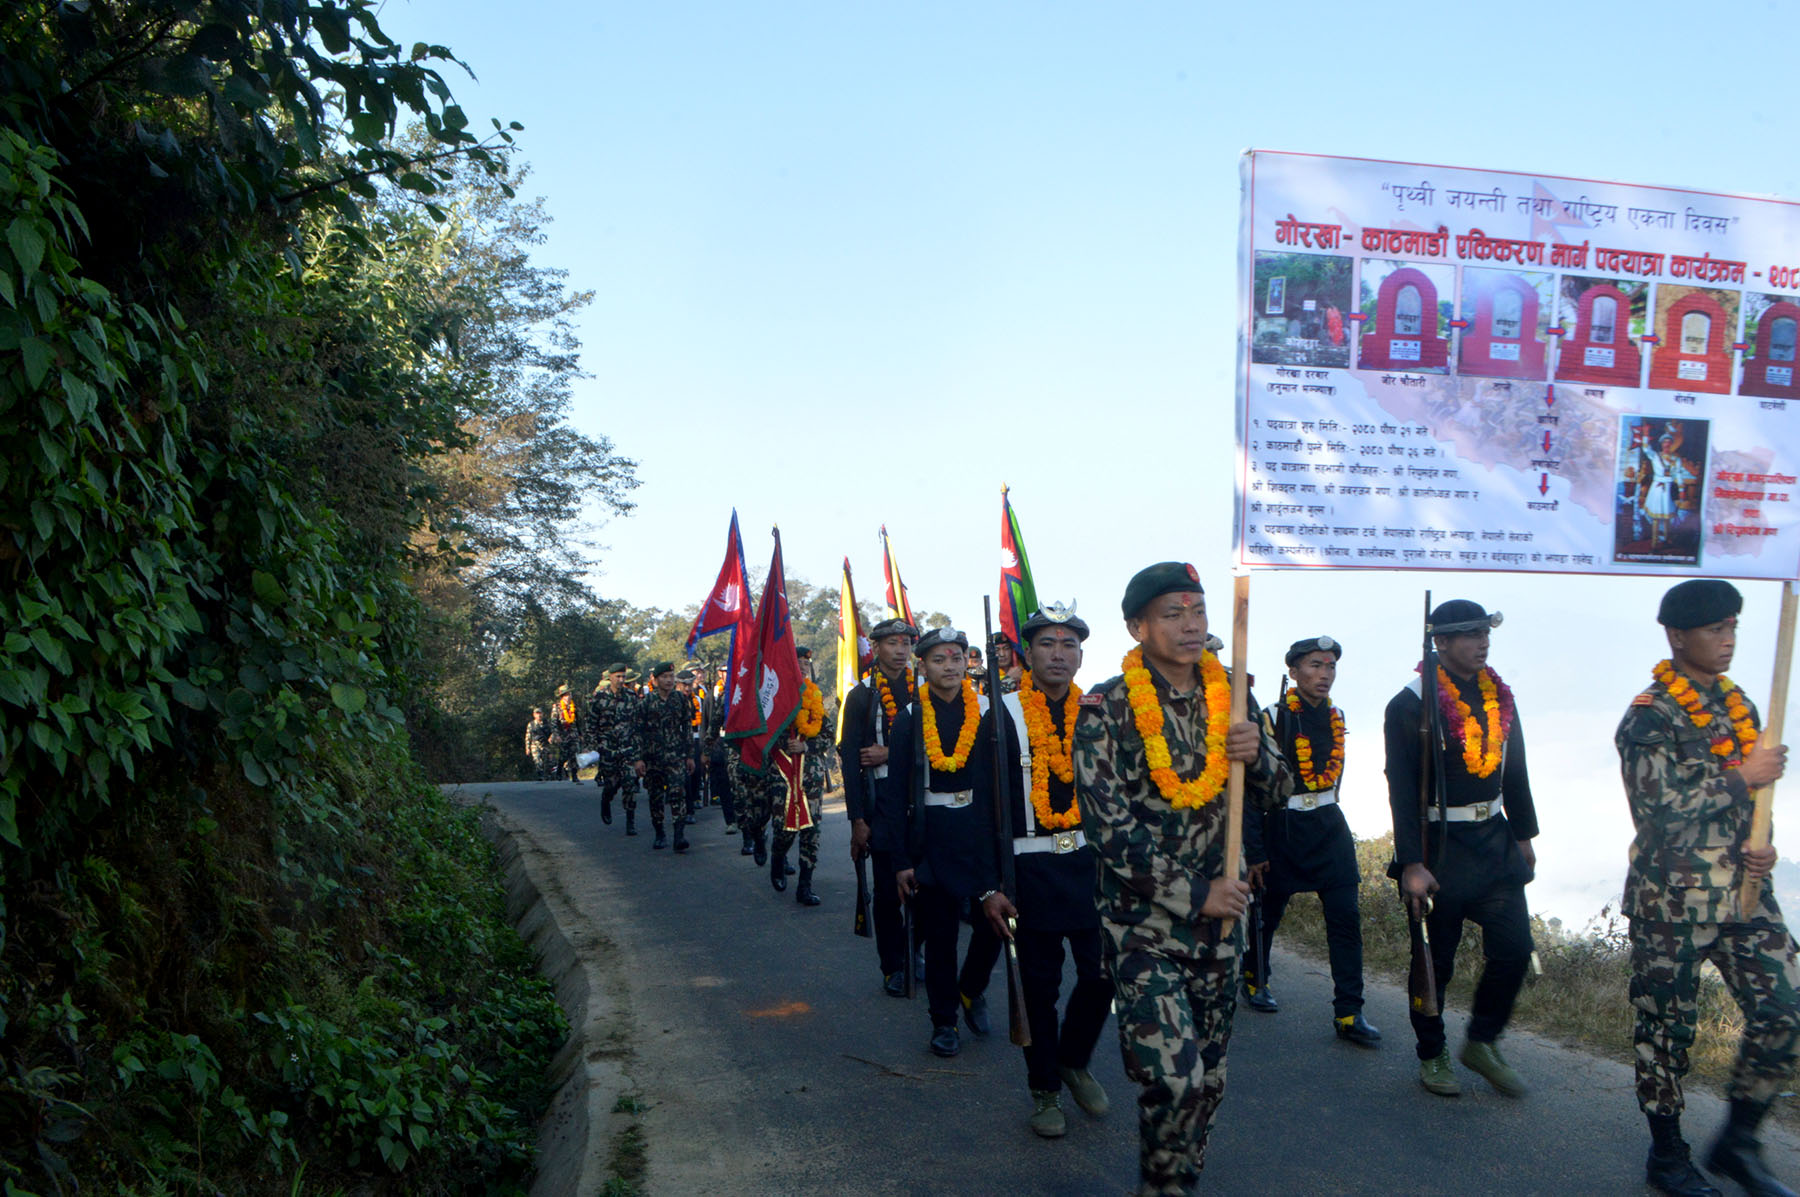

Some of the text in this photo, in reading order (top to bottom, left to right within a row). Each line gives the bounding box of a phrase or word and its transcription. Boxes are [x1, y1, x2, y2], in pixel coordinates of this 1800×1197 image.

[1446, 187, 1507, 212] जयन्ती
[1517, 196, 1553, 217] तथा
[1628, 207, 1676, 230] एकता
[1456, 228, 1545, 268] एकिकरण
[1550, 240, 1589, 270] मार्ग
[1595, 247, 1665, 278] पदयात्रा
[1670, 251, 1748, 286] कार्यक्रम
[1276, 366, 1329, 380] गोरखा दरबार
[1267, 419, 1297, 431] पदयात्रा
[1352, 424, 1376, 435] २०८०
[1360, 445, 1384, 456] २०८०
[1265, 462, 1277, 473] पद
[1281, 463, 1310, 473] यात्रामा
[1265, 525, 1295, 536] पदयात्रा
